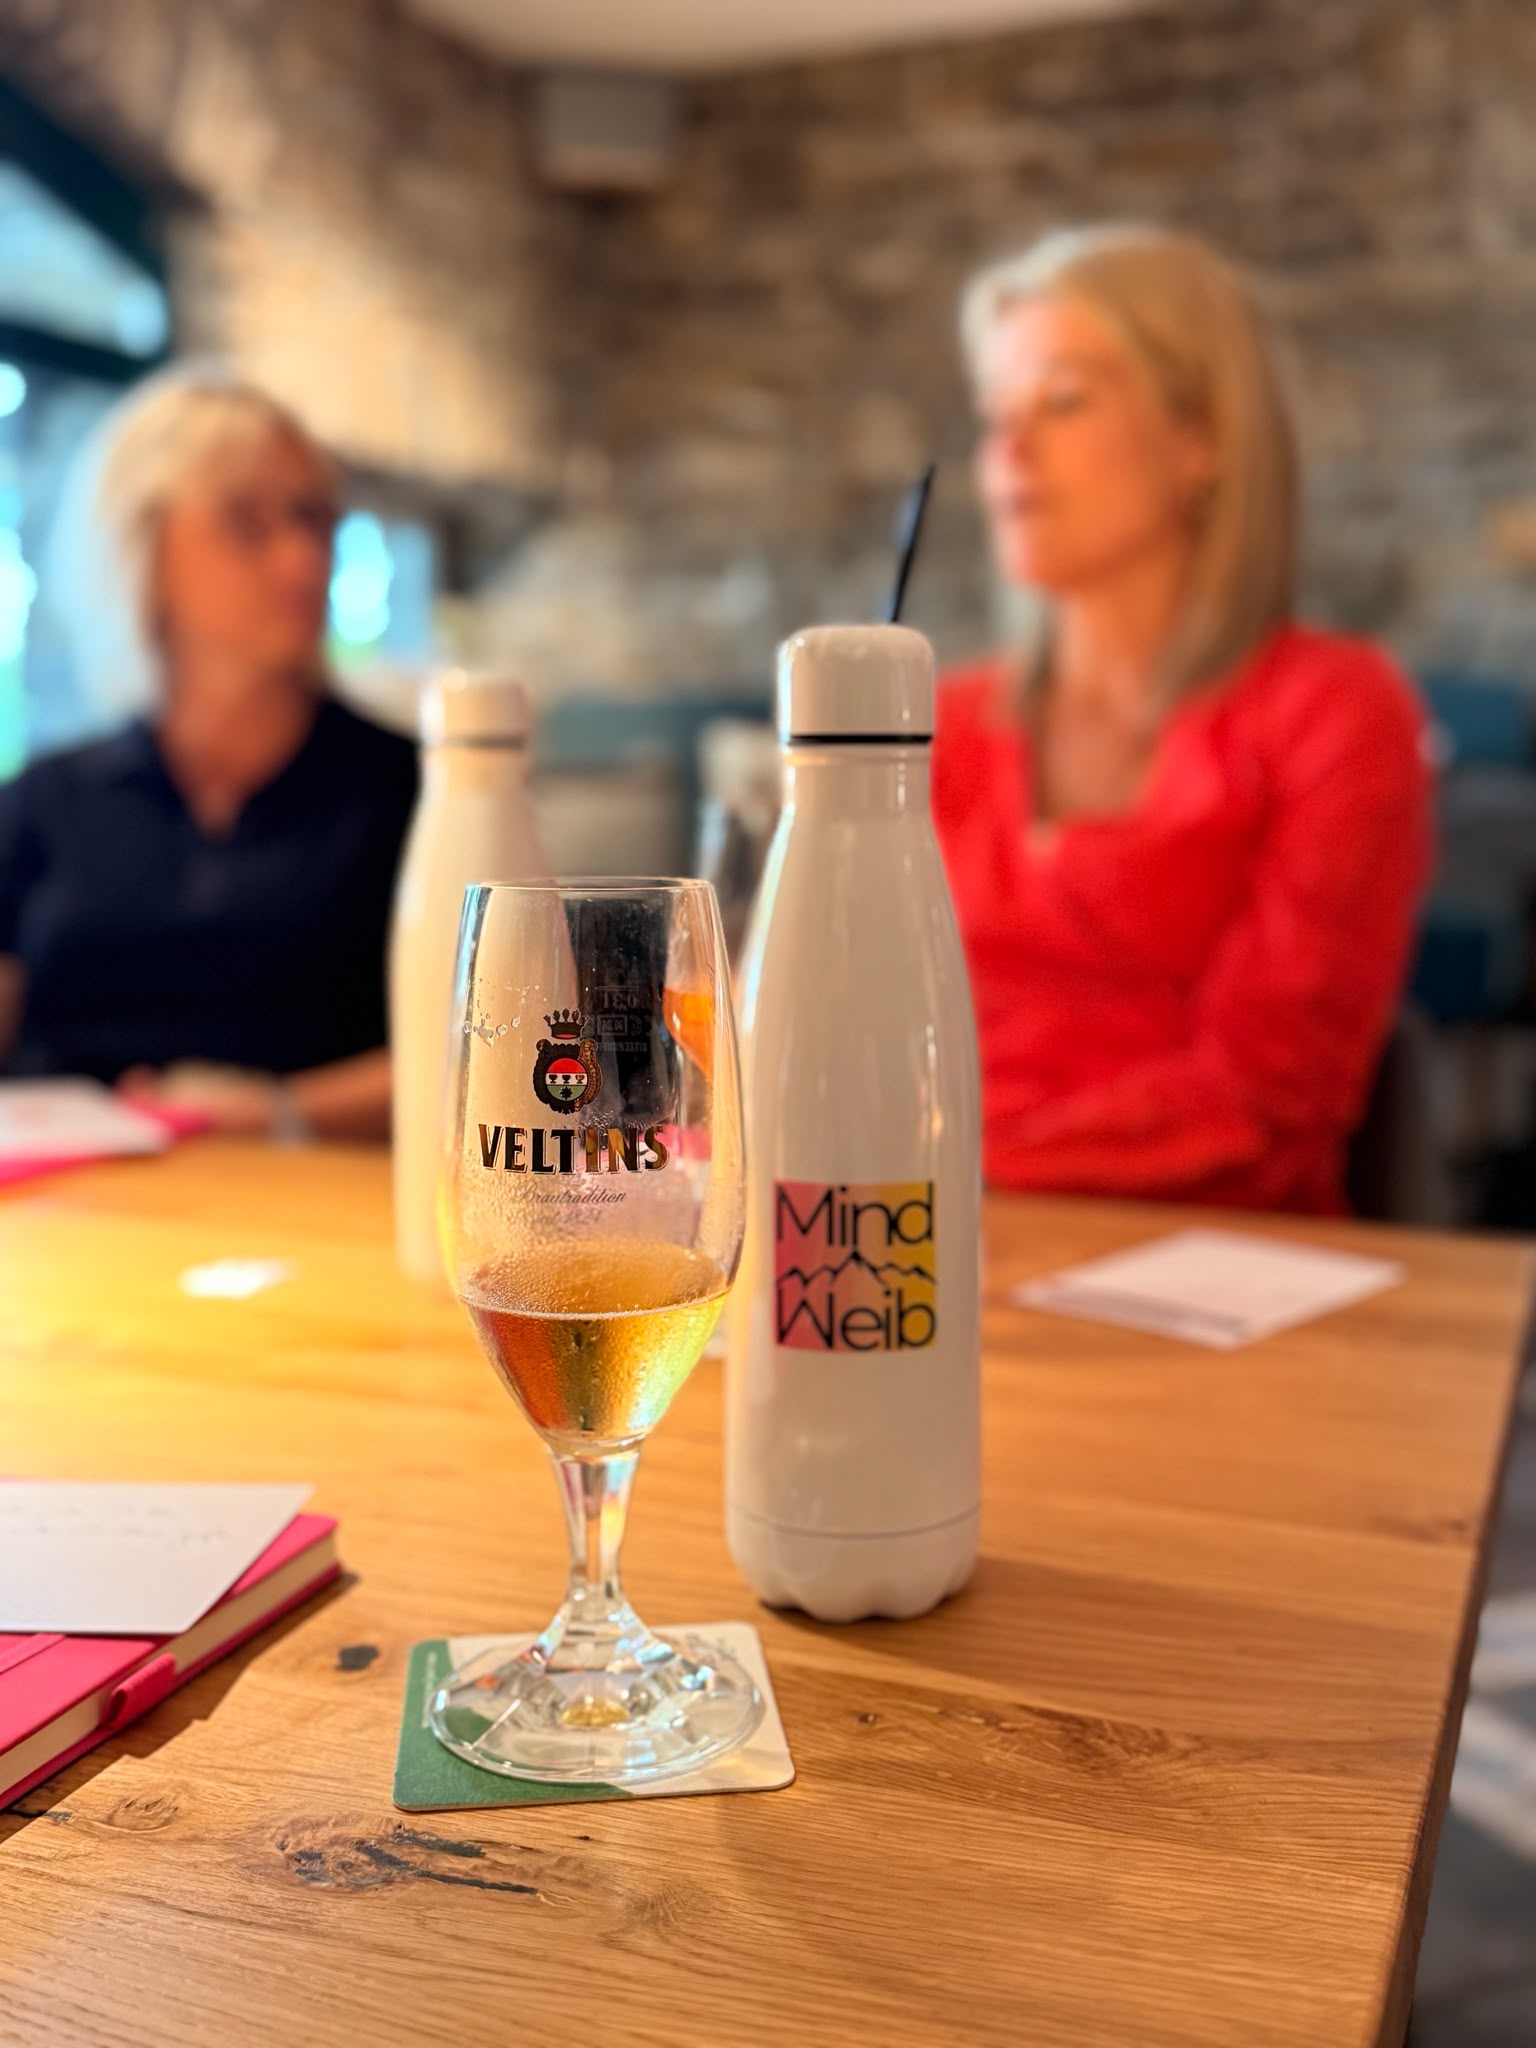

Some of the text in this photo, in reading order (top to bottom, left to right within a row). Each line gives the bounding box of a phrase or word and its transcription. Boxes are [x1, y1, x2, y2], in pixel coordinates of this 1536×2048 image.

[478, 1124, 669, 1175] VELTINS
[519, 1182, 627, 1204] Brautradition
[776, 1180, 934, 1246] Mind
[776, 1287, 936, 1351] Weib
